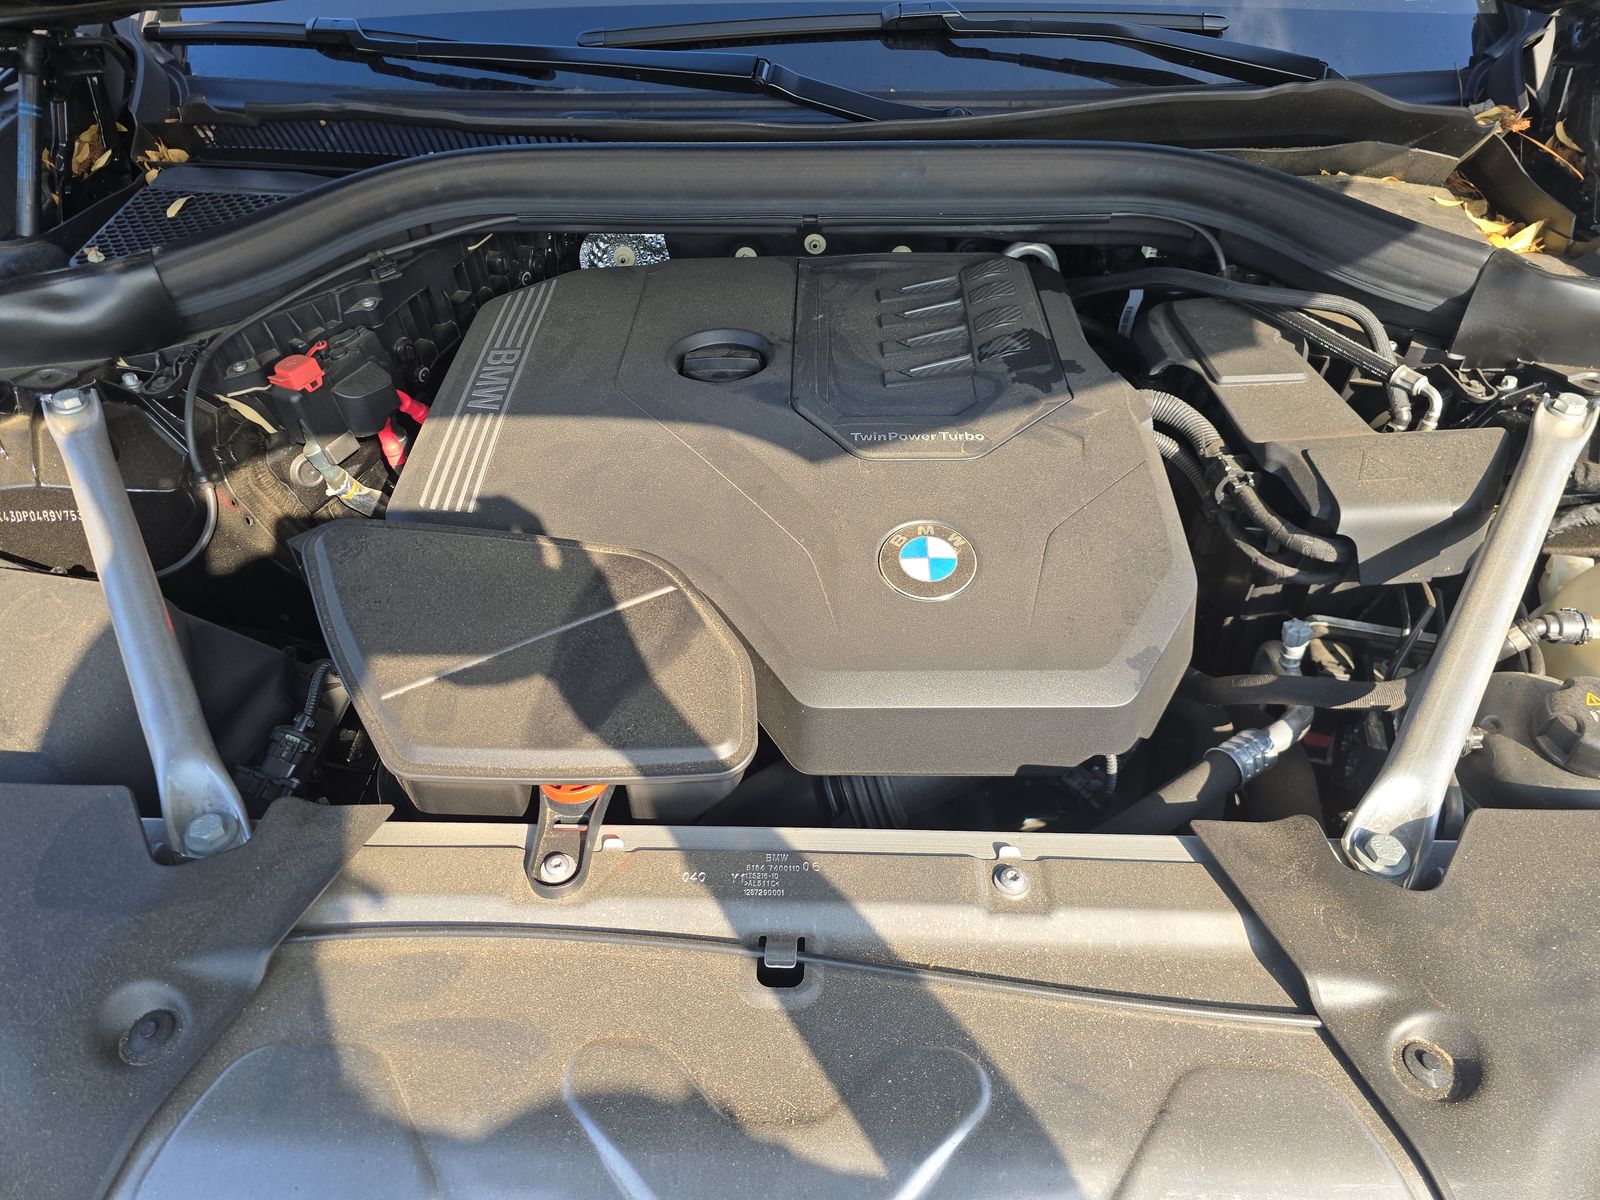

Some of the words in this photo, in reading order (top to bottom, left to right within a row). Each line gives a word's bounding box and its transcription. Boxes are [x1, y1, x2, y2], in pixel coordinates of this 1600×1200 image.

[467, 350, 521, 410] BMW
[938, 431, 985, 441] Turbo
[891, 525, 967, 553] BMW
[765, 853, 789, 862] BMW
